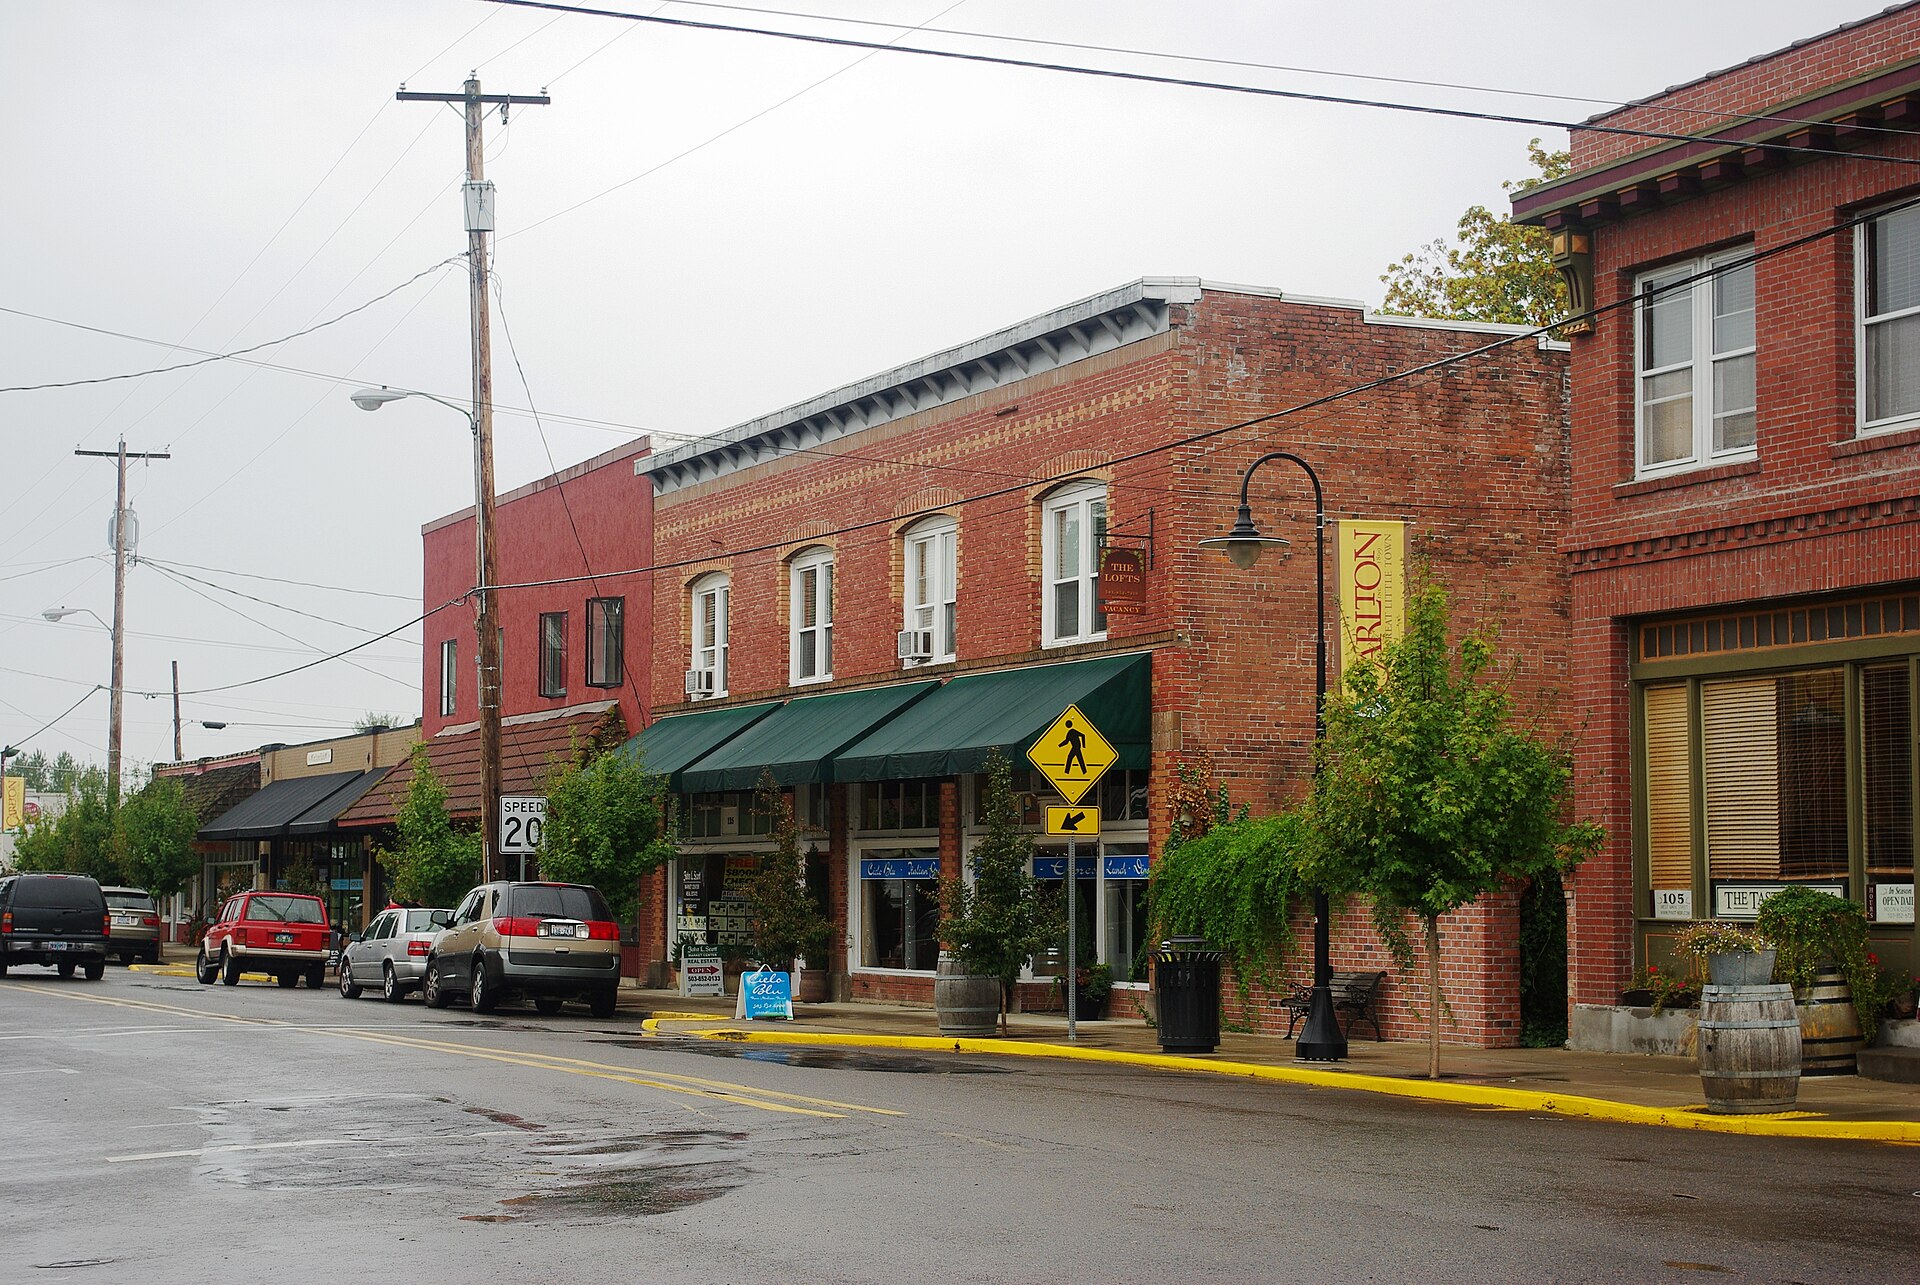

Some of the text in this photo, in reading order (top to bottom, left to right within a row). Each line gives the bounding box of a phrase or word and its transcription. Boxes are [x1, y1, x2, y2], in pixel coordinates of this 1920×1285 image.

[1384, 533, 1393, 568] TOWN
[1110, 563, 1134, 572] THE
[1104, 574, 1141, 584] LOFTS
[1384, 571, 1393, 609] LITTLE
[1103, 605, 1141, 613] VACANCY
[504, 801, 544, 813] SPEED
[504, 816, 543, 847] 20
[1105, 859, 1127, 875] Lunch
[1895, 886, 1912, 895] Season
[1663, 893, 1685, 905] 105
[1723, 891, 1749, 909] THE
[1882, 896, 1900, 906] OPEN
[748, 972, 785, 984] Cielo
[752, 983, 784, 995] Blu
